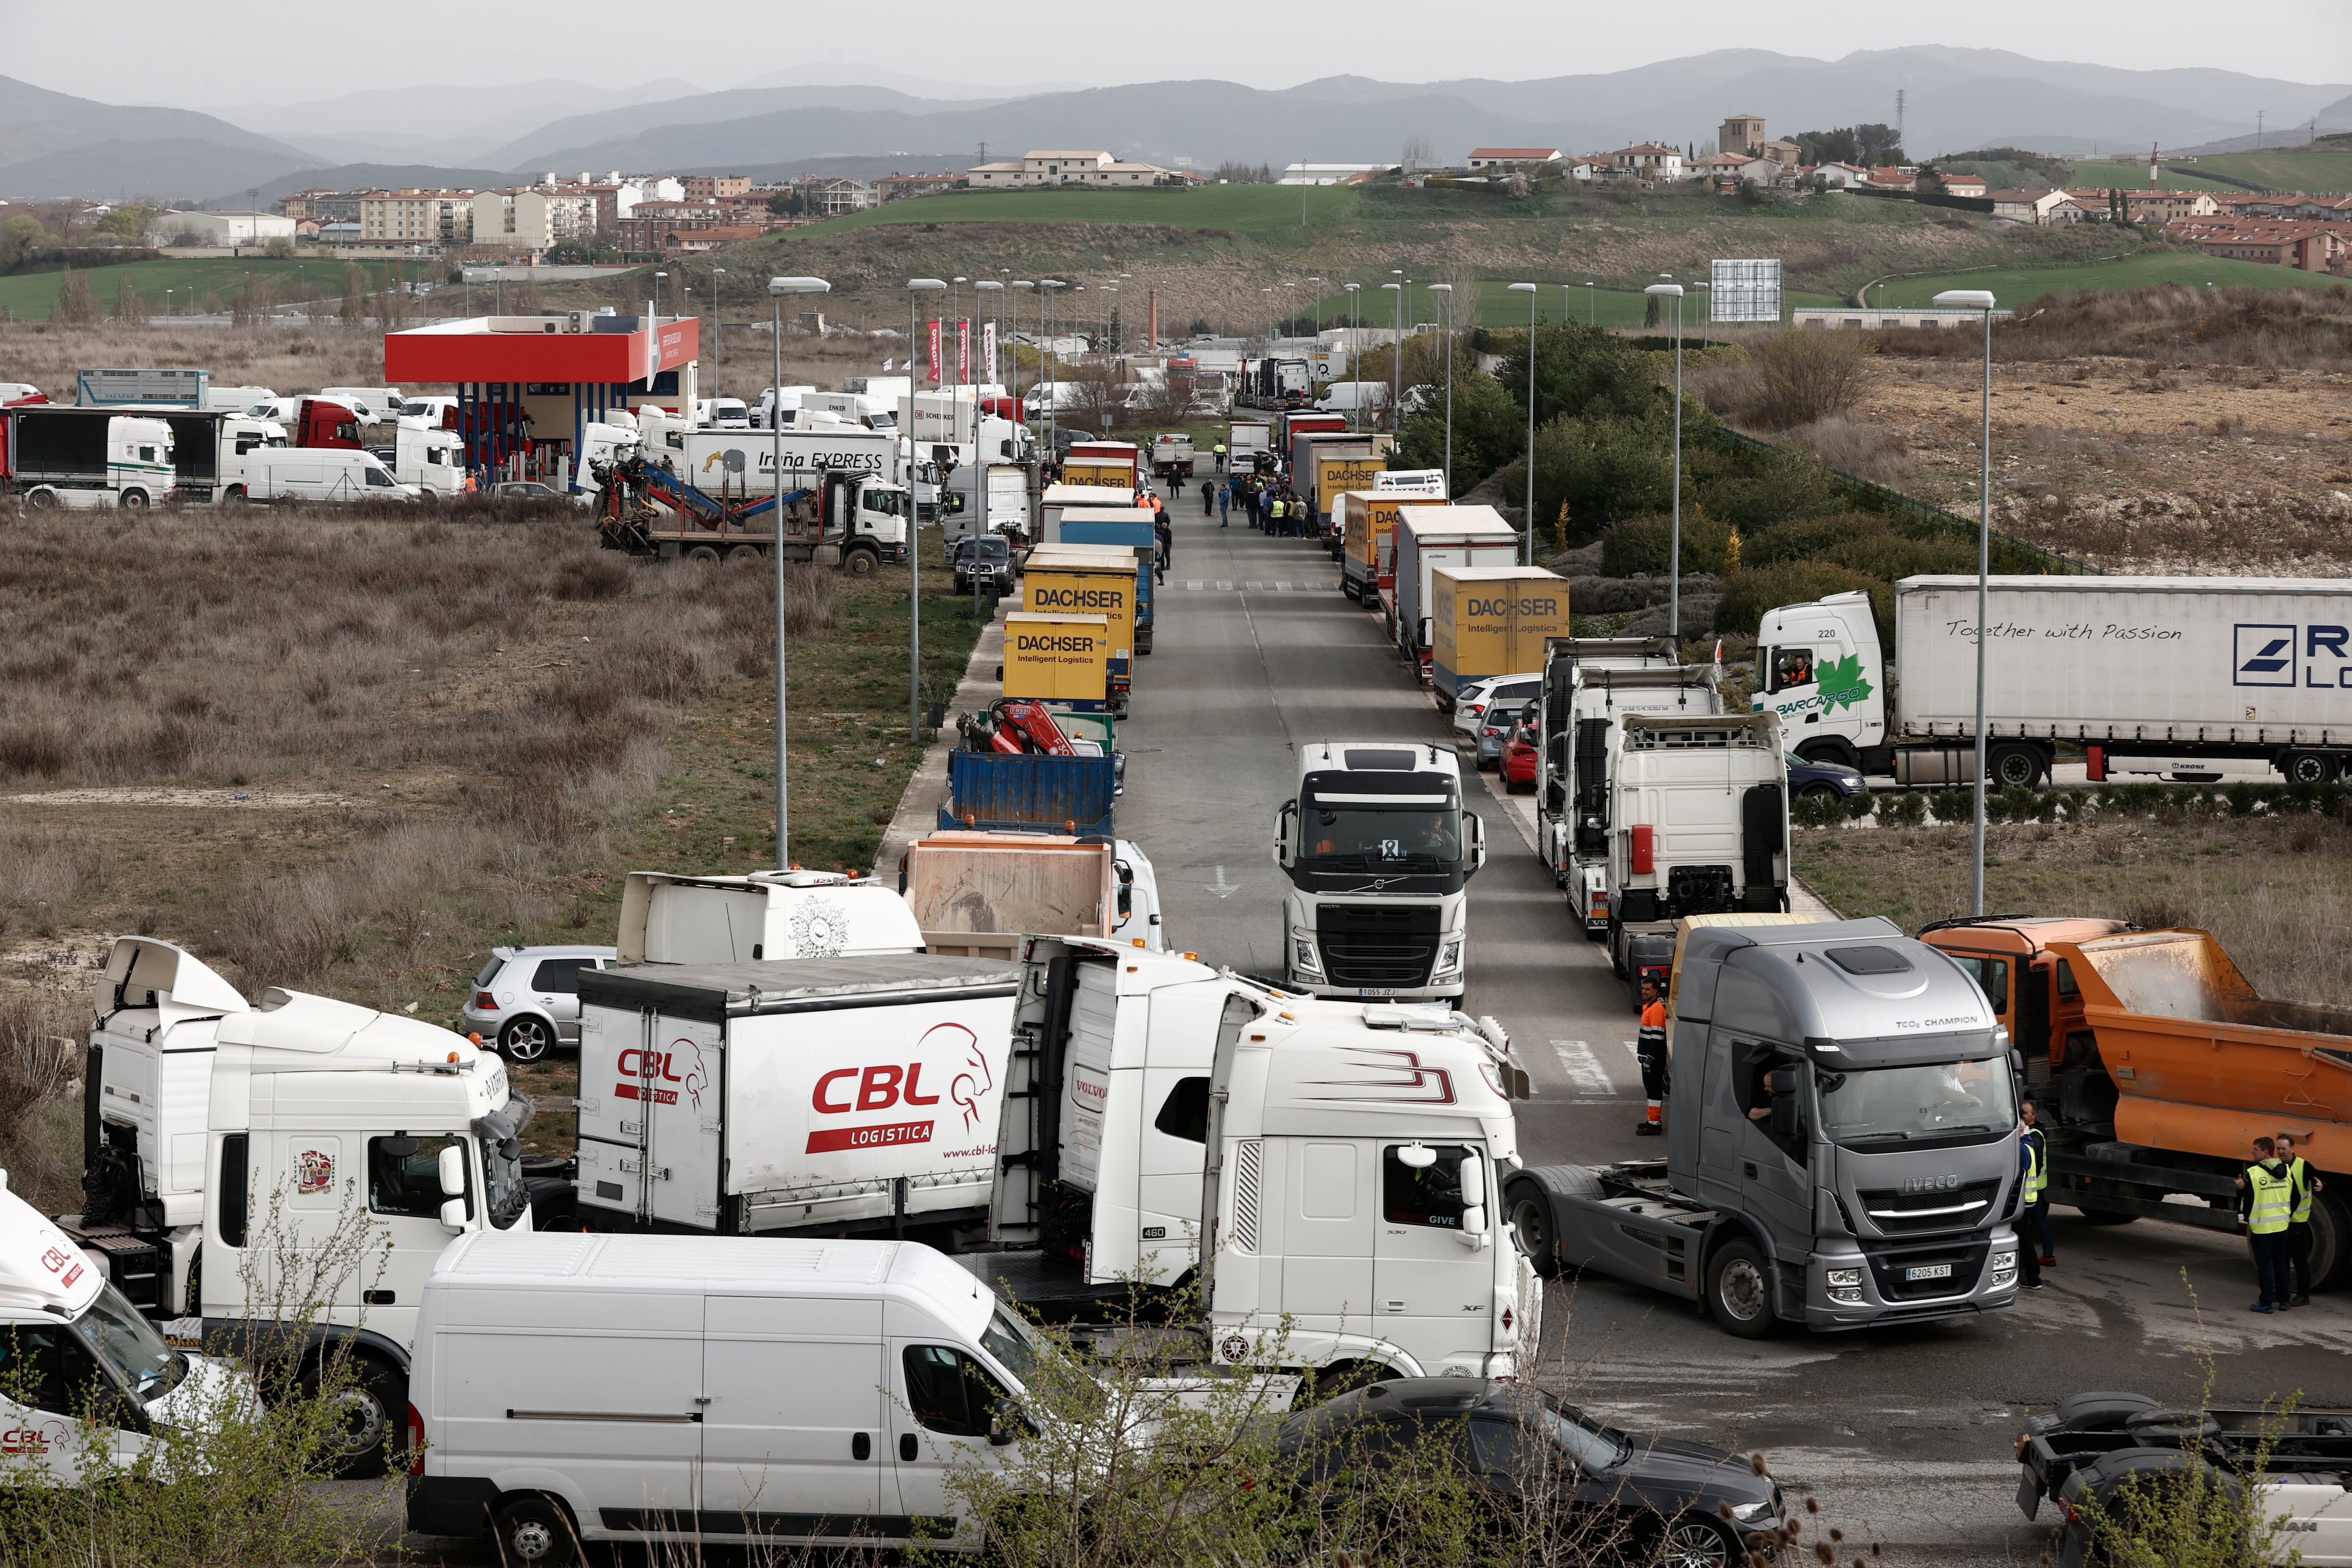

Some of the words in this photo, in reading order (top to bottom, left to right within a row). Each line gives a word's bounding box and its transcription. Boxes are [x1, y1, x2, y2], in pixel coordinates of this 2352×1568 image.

[759, 451, 804, 467] Irña
[811, 453, 882, 469] EXPRESS
[1069, 477, 1126, 488] DACHSER
[1035, 589, 1123, 608] DACHSER
[1468, 598, 1557, 616] DACHSER
[1818, 630, 1836, 638] 220
[2045, 624, 2092, 639] with
[2102, 624, 2182, 639] Passion
[1018, 635, 1093, 652] DACHSER
[1018, 655, 1056, 664] Intelligent
[1058, 656, 1094, 664] Logistics
[1775, 687, 1861, 715] BARCARGO
[1924, 1016, 1978, 1026] CHAMPION
[618, 1049, 682, 1082] CBL
[637, 1088, 676, 1103] LOSTICA
[812, 1063, 940, 1114] CBL
[1076, 1080, 1105, 1099] VOLVO
[851, 1125, 930, 1145] LOGISTICA
[1904, 1174, 1958, 1193] IVECO
[1429, 1215, 1455, 1225] GIVE
[1144, 1228, 1164, 1237] 460
[41, 1246, 71, 1273] CBL
[1911, 1268, 1932, 1278] 6205
[1934, 1266, 1950, 1276] KST
[3, 1430, 51, 1443] CBL
